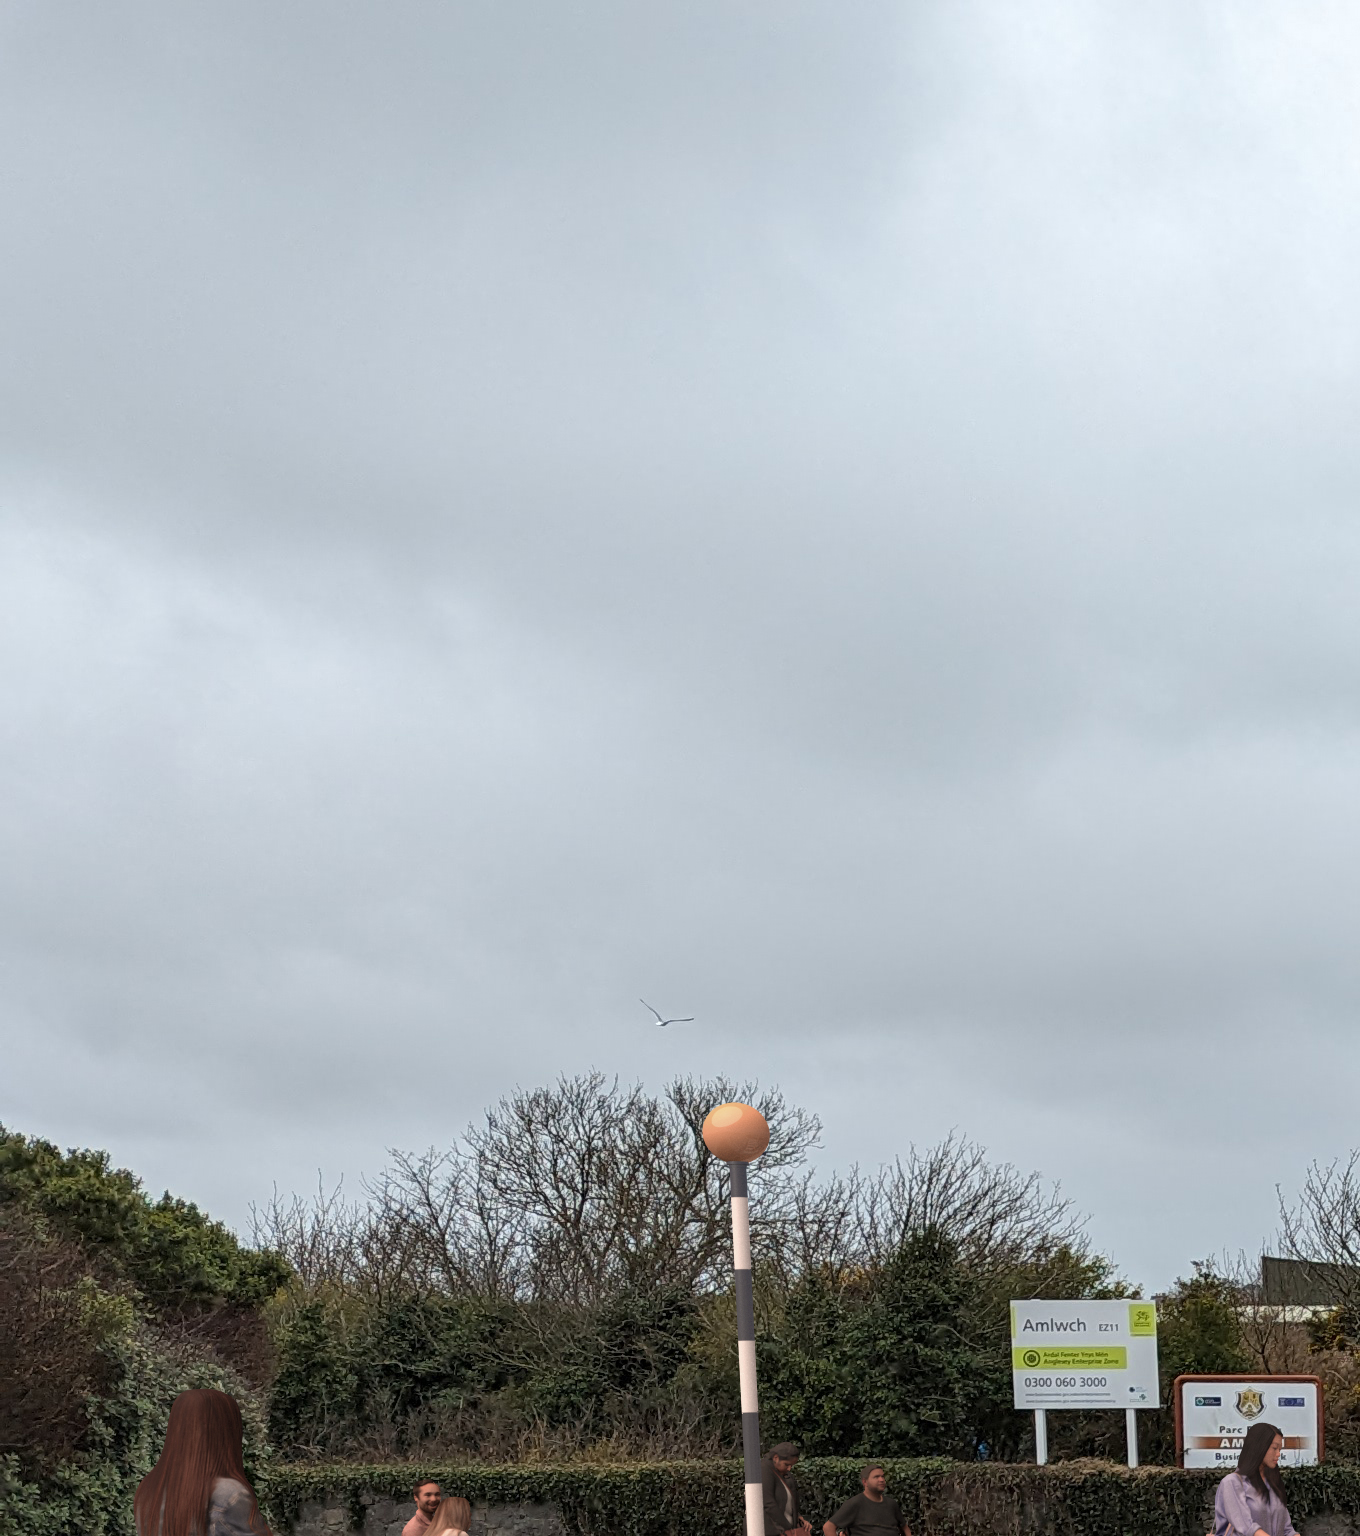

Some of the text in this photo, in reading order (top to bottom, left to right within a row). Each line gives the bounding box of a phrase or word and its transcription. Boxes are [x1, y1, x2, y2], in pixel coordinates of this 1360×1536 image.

[1022, 1317, 1119, 1332] Amlwch EZ11
[1024, 1376, 1107, 1388] 0300 060 3000
[1219, 1425, 1243, 1434] Parc
